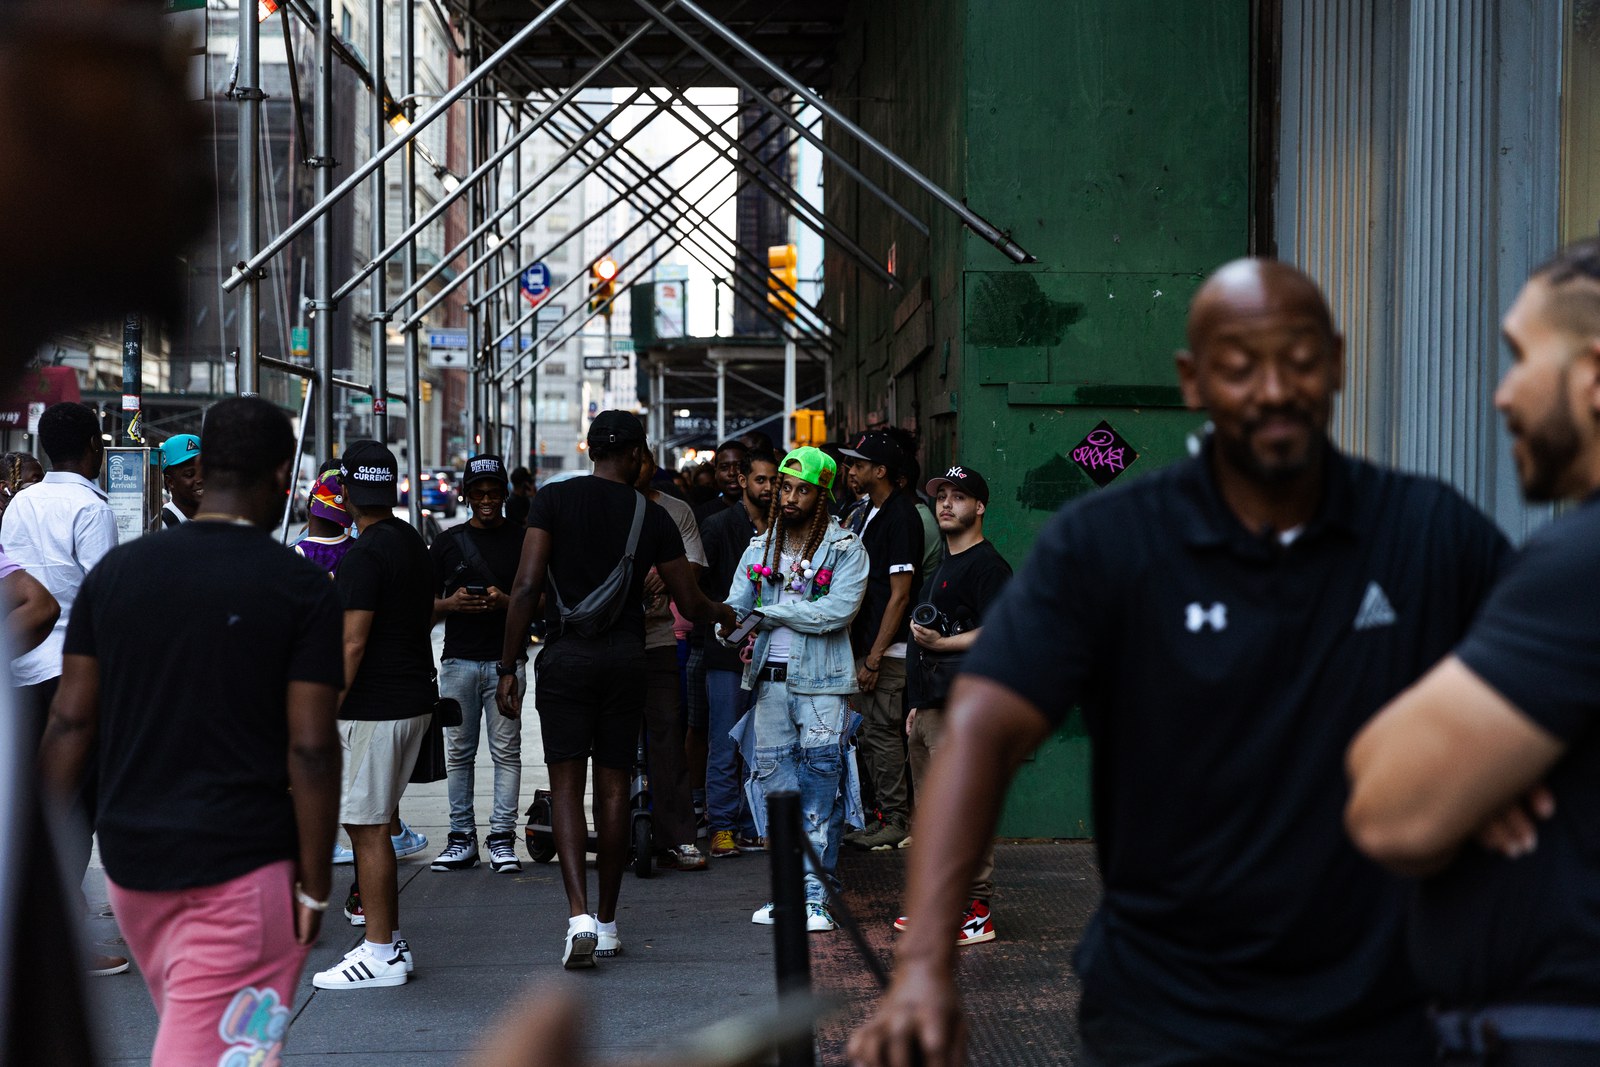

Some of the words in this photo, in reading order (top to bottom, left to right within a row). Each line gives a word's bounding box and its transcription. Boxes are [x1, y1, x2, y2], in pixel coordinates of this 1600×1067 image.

[358, 465, 391, 475] GLOBAL
[471, 464, 500, 473] DISTRICT
[946, 466, 963, 477] NY
[353, 472, 395, 482] CURRENCY
[576, 932, 597, 940] GUESS
